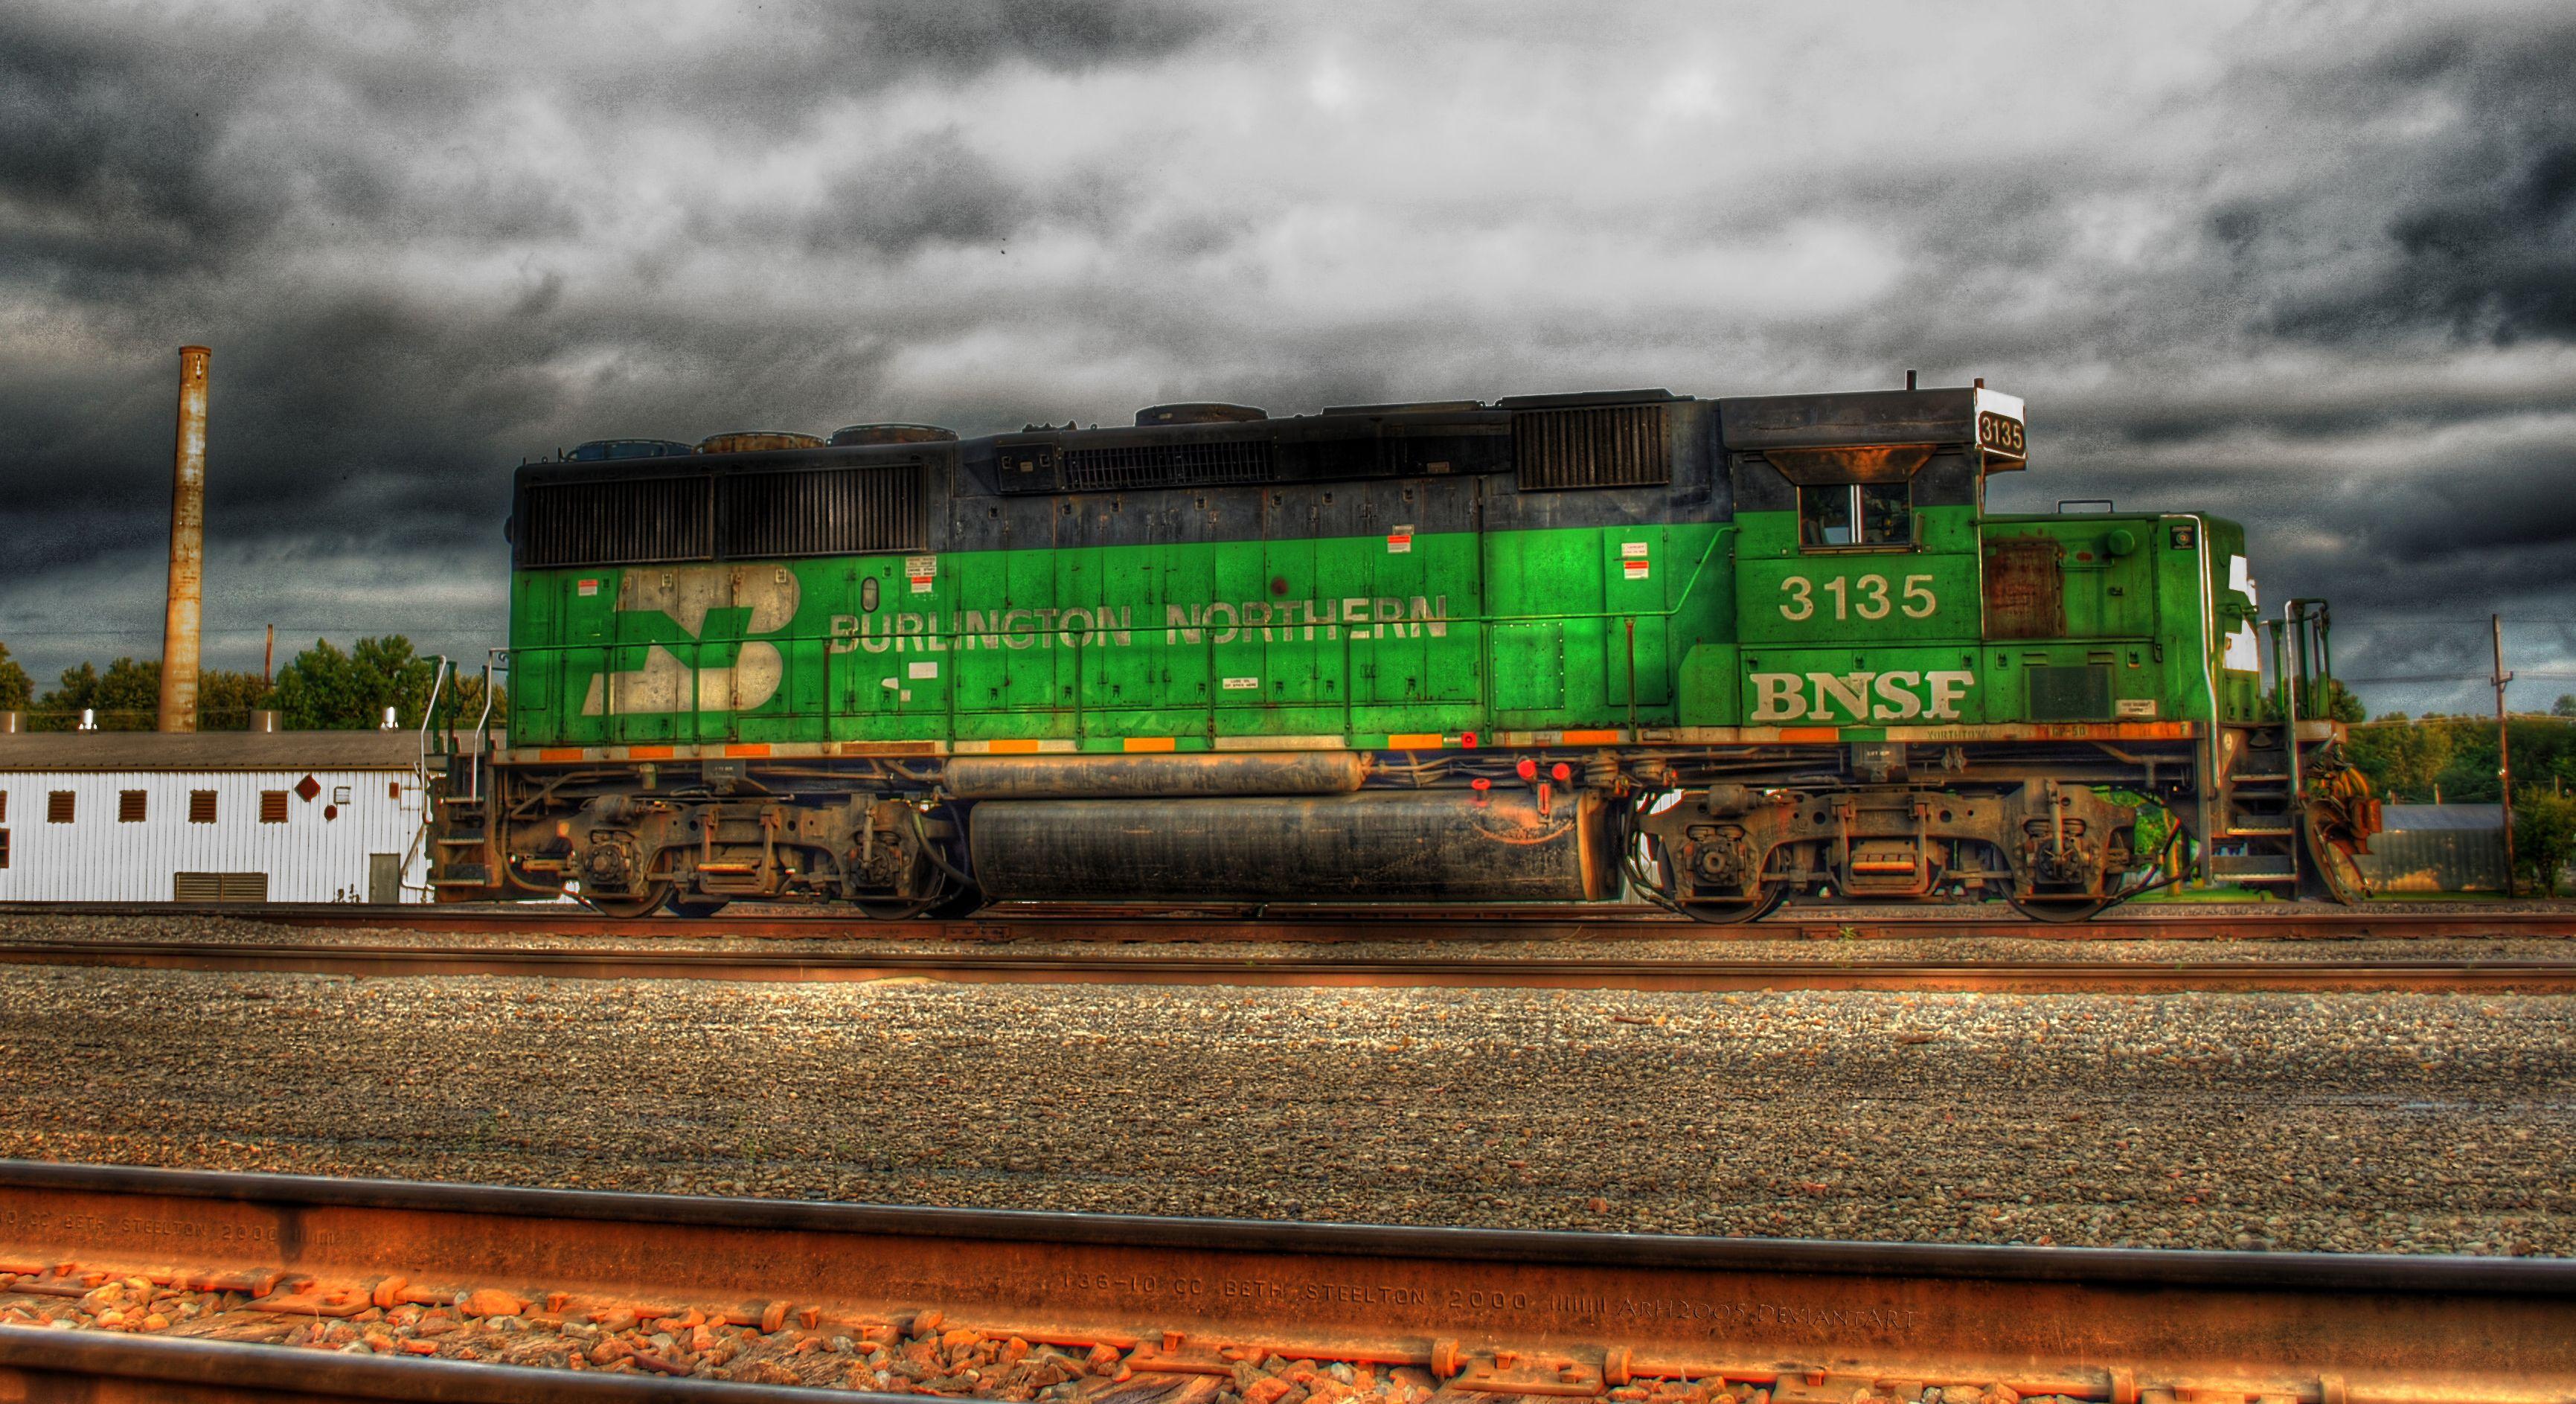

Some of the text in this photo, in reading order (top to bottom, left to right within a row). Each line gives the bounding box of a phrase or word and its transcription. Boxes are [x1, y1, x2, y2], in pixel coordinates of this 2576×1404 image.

[1982, 417, 2022, 449] 3135
[1779, 574, 1936, 621] 3135
[829, 594, 1447, 653] BURLINGTON NORTHERN
[1749, 670, 1975, 721] BNSF
[121, 1218, 206, 1237] STEELTON
[223, 1225, 277, 1241] 2000
[1064, 1273, 1156, 1292] 136-10
[1174, 1278, 1201, 1295] CC
[1225, 1280, 1284, 1298] BETH
[1306, 1283, 1424, 1305] STEELTON
[1449, 1290, 1525, 1309] 2000
